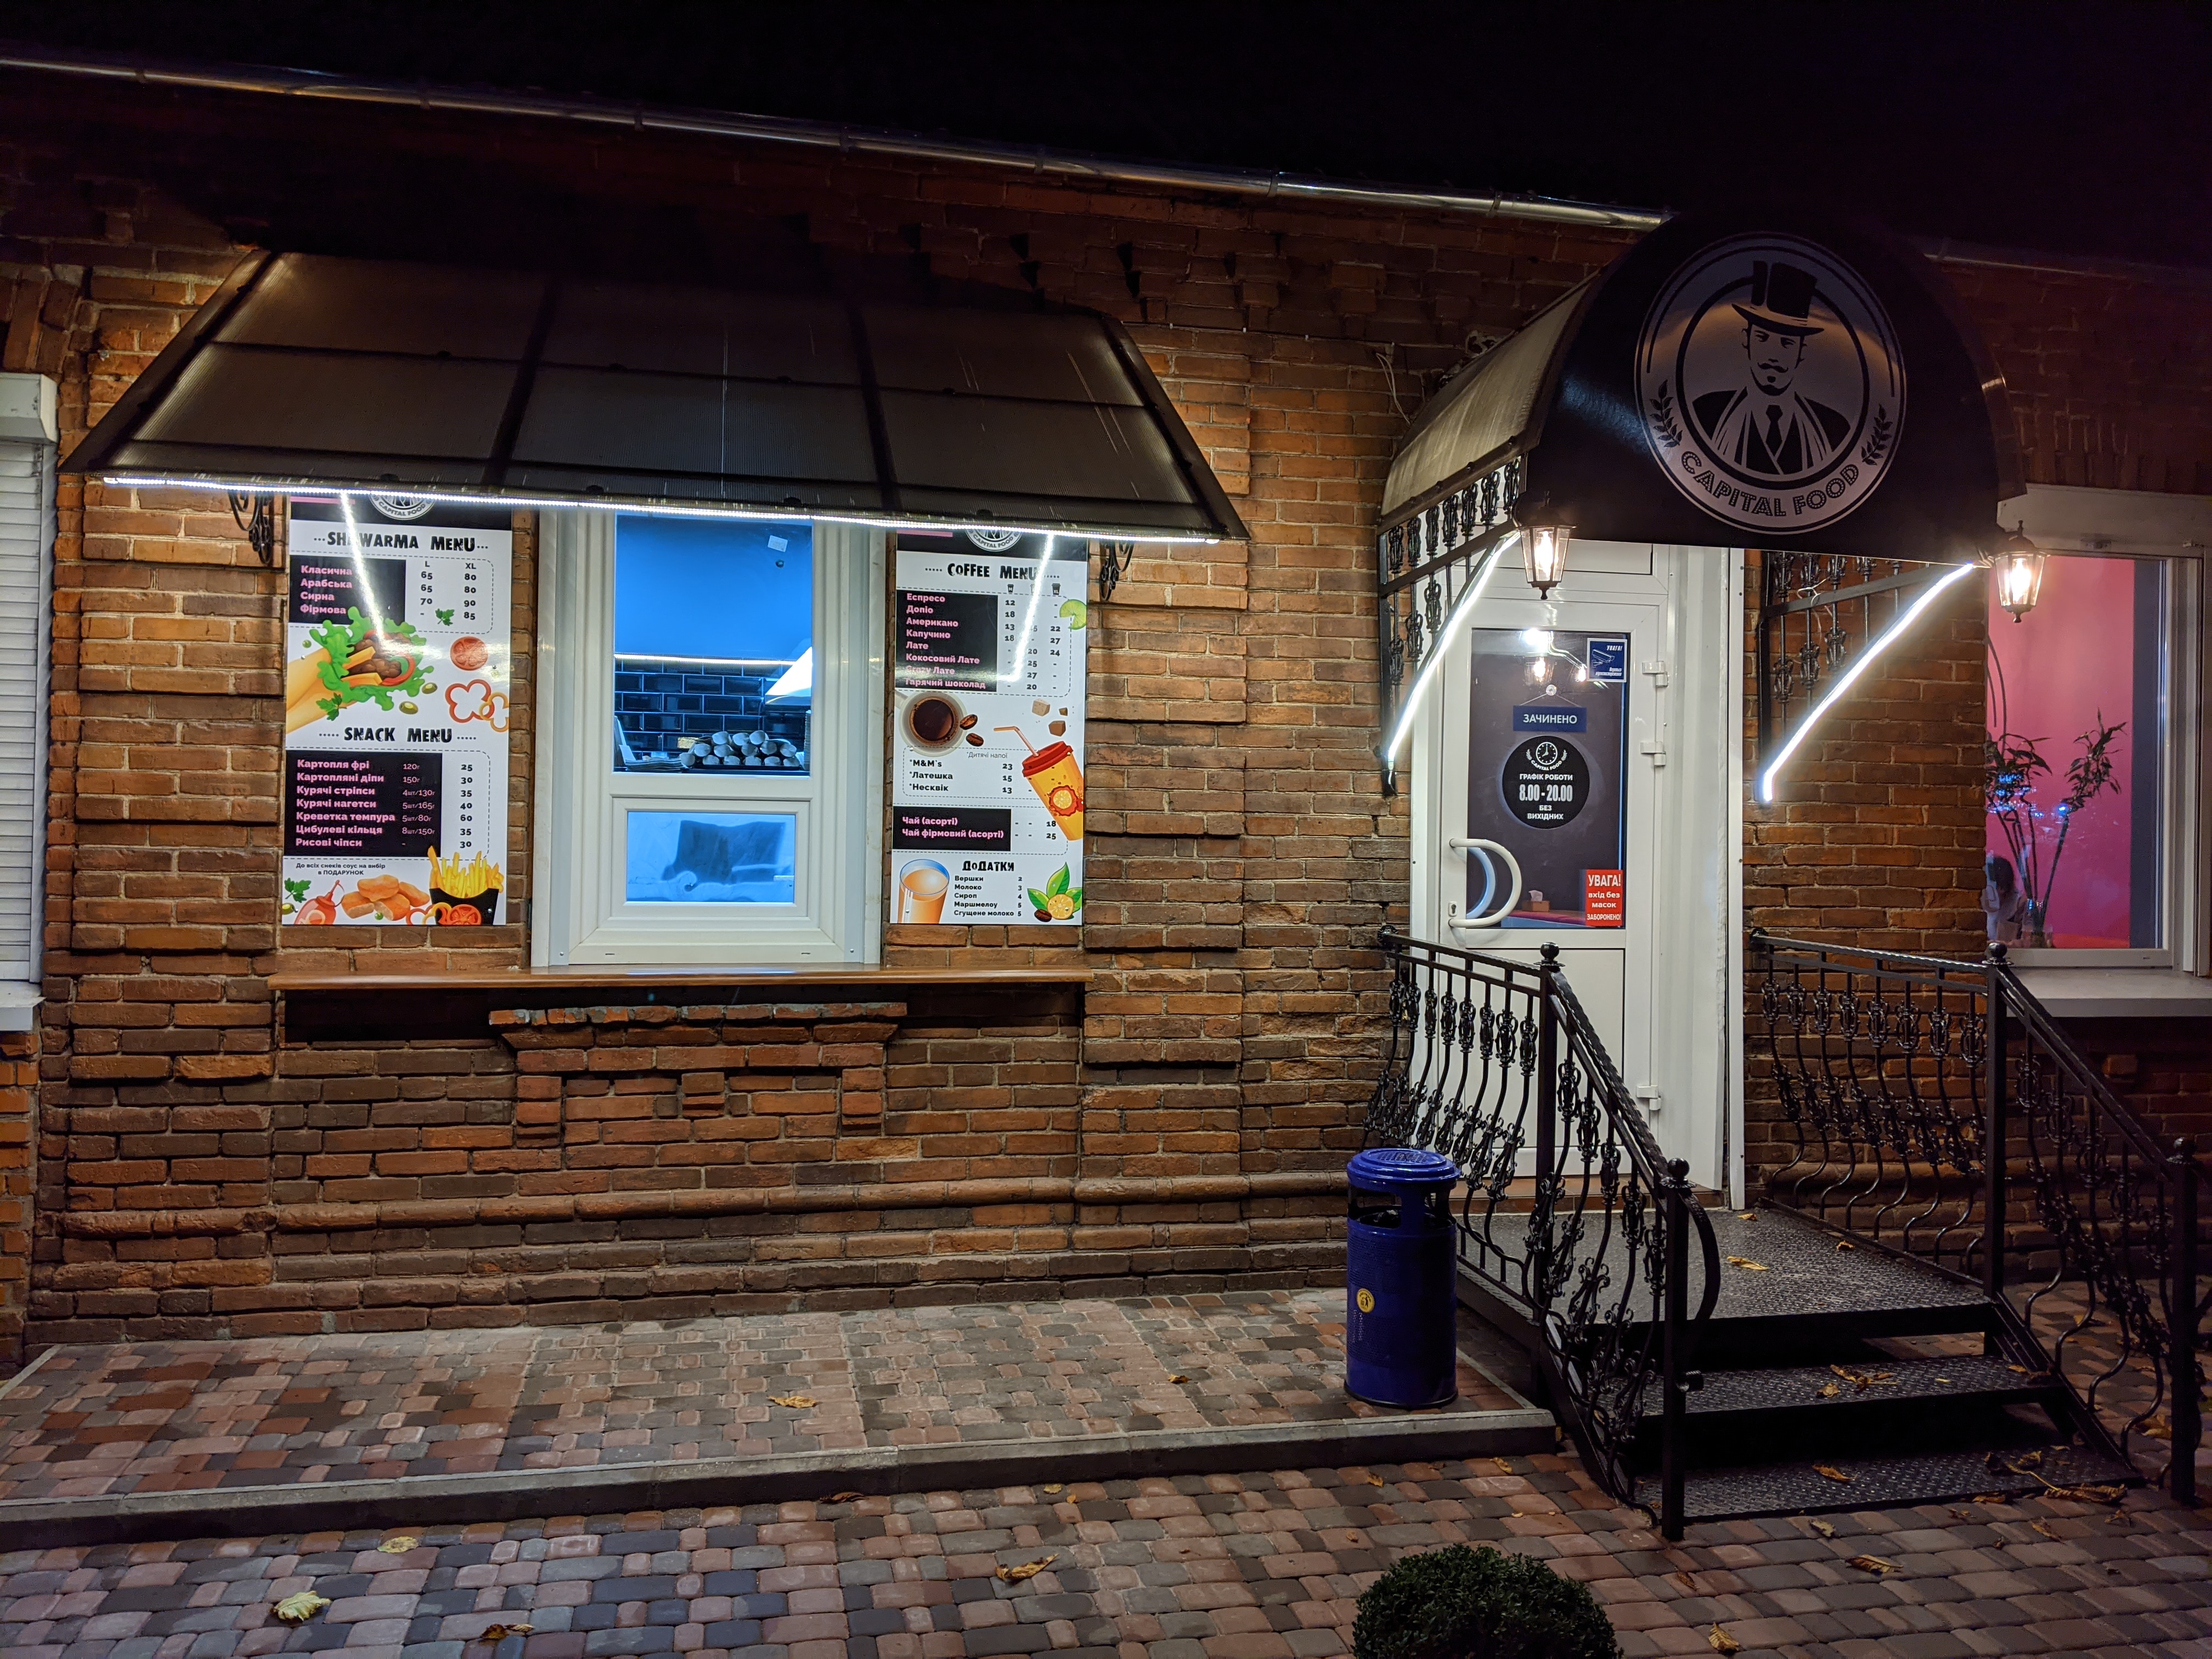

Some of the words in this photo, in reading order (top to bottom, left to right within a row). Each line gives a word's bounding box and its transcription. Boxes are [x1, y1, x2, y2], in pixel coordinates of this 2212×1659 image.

[1681, 451, 1786, 516] CAPITAL
[1793, 464, 1859, 515] FOOD
[379, 501, 406, 516] CAPITAL
[408, 504, 425, 515] FOOD
[430, 536, 475, 552] MENU
[973, 534, 997, 548] CAPITAL
[998, 537, 1013, 548] FOOD
[301, 566, 352, 575] Класична
[421, 571, 432, 579] 65
[947, 563, 990, 577] COFFEE
[1000, 566, 1038, 580] MENU
[301, 578, 352, 588] Арабська
[421, 584, 432, 592] 65
[300, 591, 334, 601] Сирна
[907, 593, 945, 603] Еспресо
[300, 604, 346, 614] Фірмова
[906, 605, 933, 614] Допіо
[464, 612, 475, 620] 85
[906, 617, 958, 627] Американо
[906, 629, 951, 639] Капучино
[906, 653, 955, 662] Кокосовий
[957, 656, 980, 664] Лате
[906, 678, 943, 686] Гарячий
[1523, 714, 1577, 724] ЗАЧИНЕНО
[344, 727, 396, 742] SNACK
[407, 728, 452, 743] MENU
[297, 759, 348, 769] Картопля
[351, 761, 369, 770] фрі
[1531, 760, 1549, 770] CAPITAL
[1550, 760, 1562, 770] FOOD
[297, 772, 358, 783] Картопляні
[360, 774, 384, 783] діпи
[297, 786, 331, 795] Курячі
[334, 786, 375, 796] стріпси
[296, 799, 331, 809] Курячі
[296, 812, 347, 821] Креветка
[350, 814, 395, 822] темпура
[922, 817, 957, 826] (асорті)
[296, 825, 345, 835] Цибулеві
[347, 826, 382, 834] кільця
[922, 830, 966, 838] фірмовий
[968, 830, 1003, 839] (асорті)
[1588, 874, 1621, 886] УВАГА!
